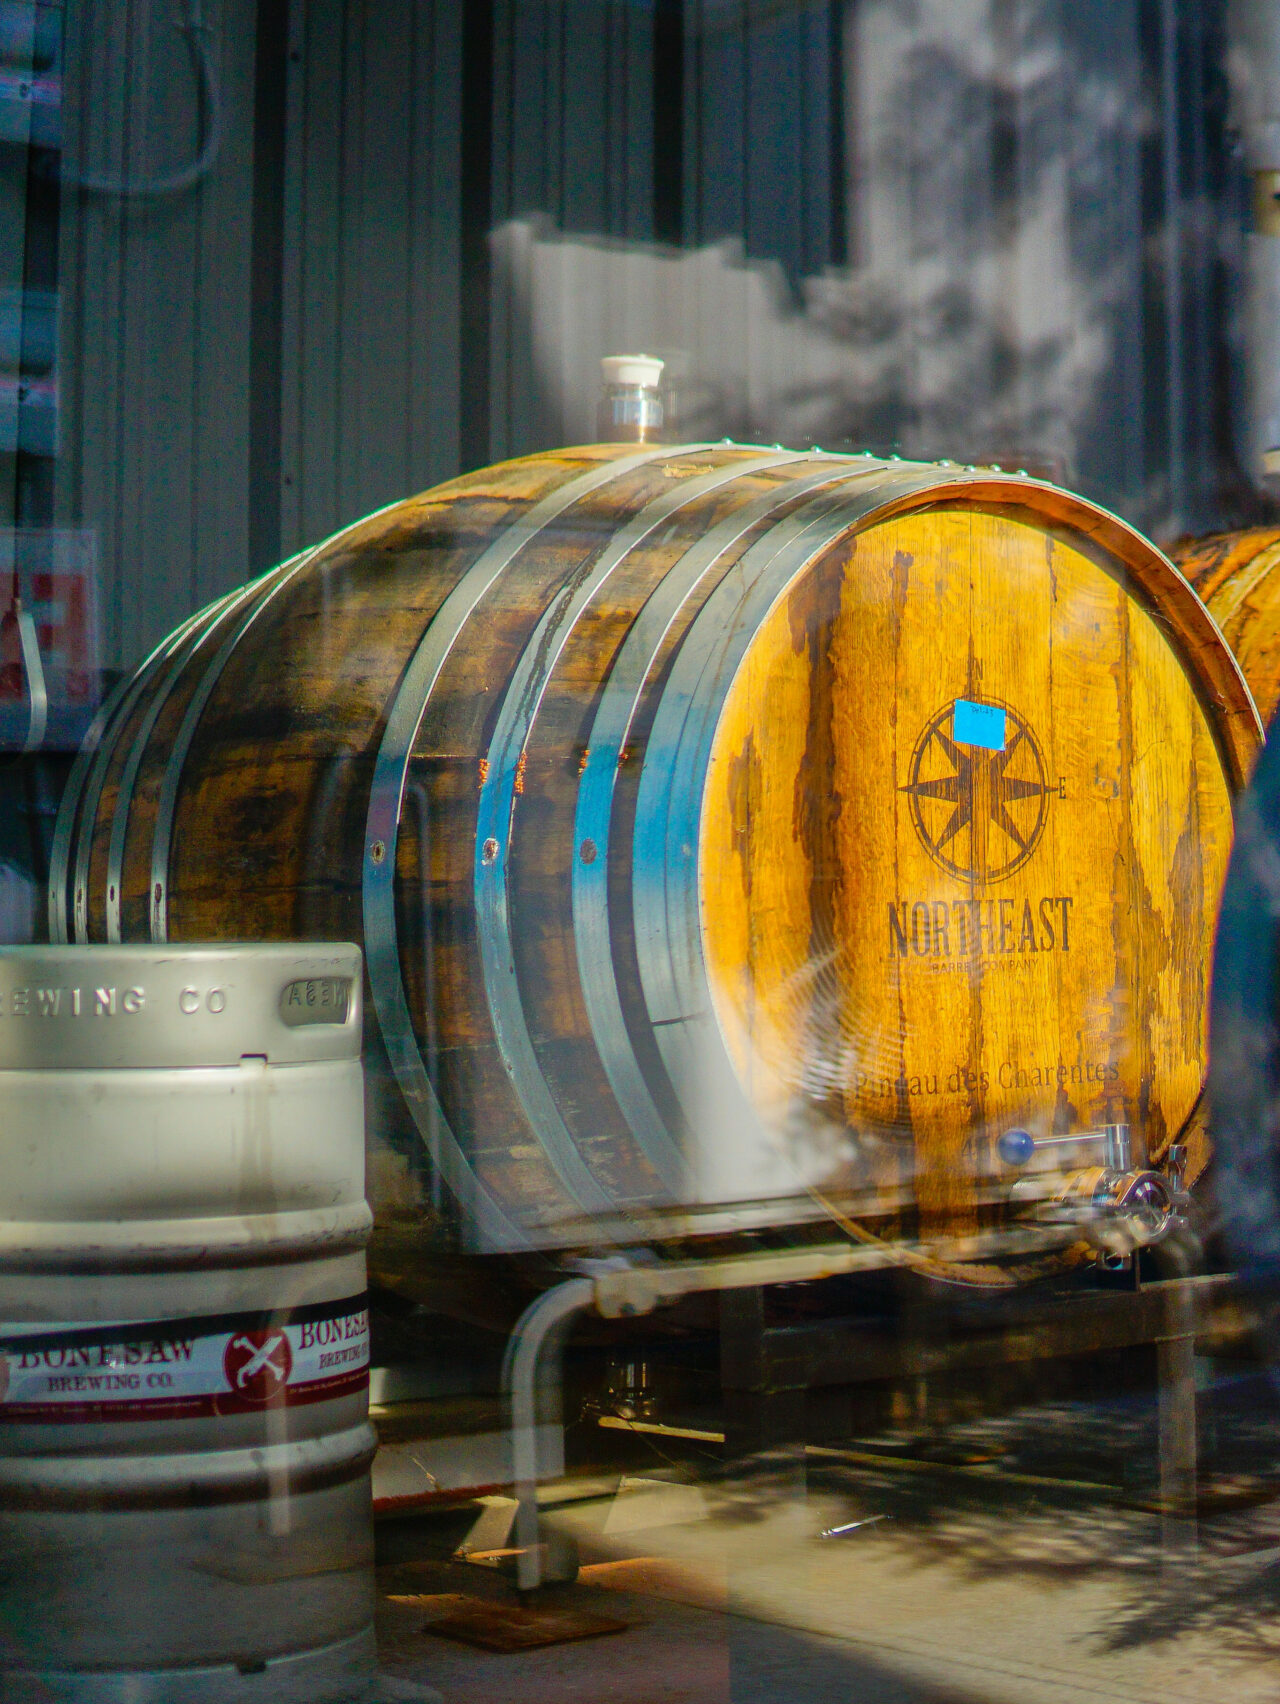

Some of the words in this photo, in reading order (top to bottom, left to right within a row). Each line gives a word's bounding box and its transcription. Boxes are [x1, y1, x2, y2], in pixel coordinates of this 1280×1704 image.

[1058, 777, 1066, 799] E
[887, 896, 1074, 957] NORTHEAST
[0, 985, 146, 1017] EWING
[178, 984, 226, 1015] CO
[946, 1063, 990, 1093] des
[998, 1059, 1119, 1090] Charentes
[47, 1373, 141, 1392] BREWING
